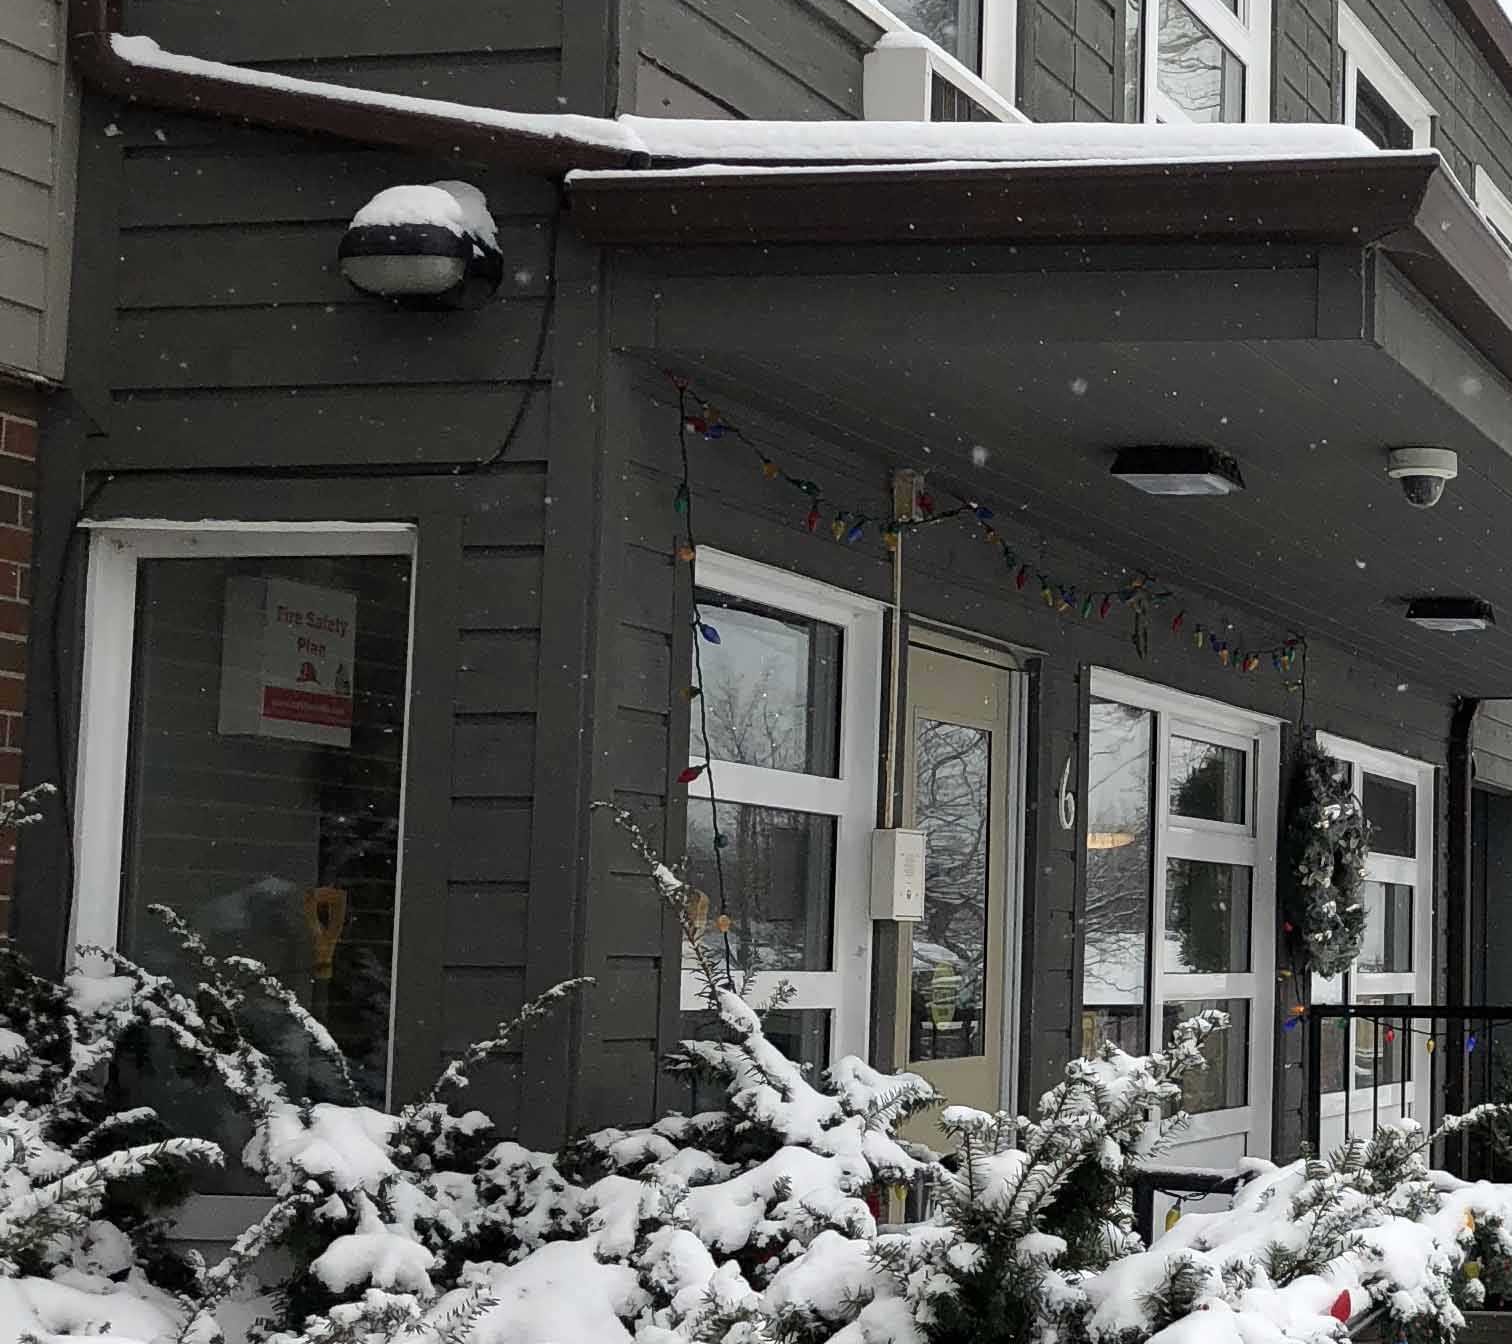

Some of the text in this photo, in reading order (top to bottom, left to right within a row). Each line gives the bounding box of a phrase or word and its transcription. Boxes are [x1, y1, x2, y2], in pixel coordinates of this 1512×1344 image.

[277, 607, 349, 639] Fire Safety
[297, 636, 327, 657] Plan
[1059, 756, 1075, 830] 6
